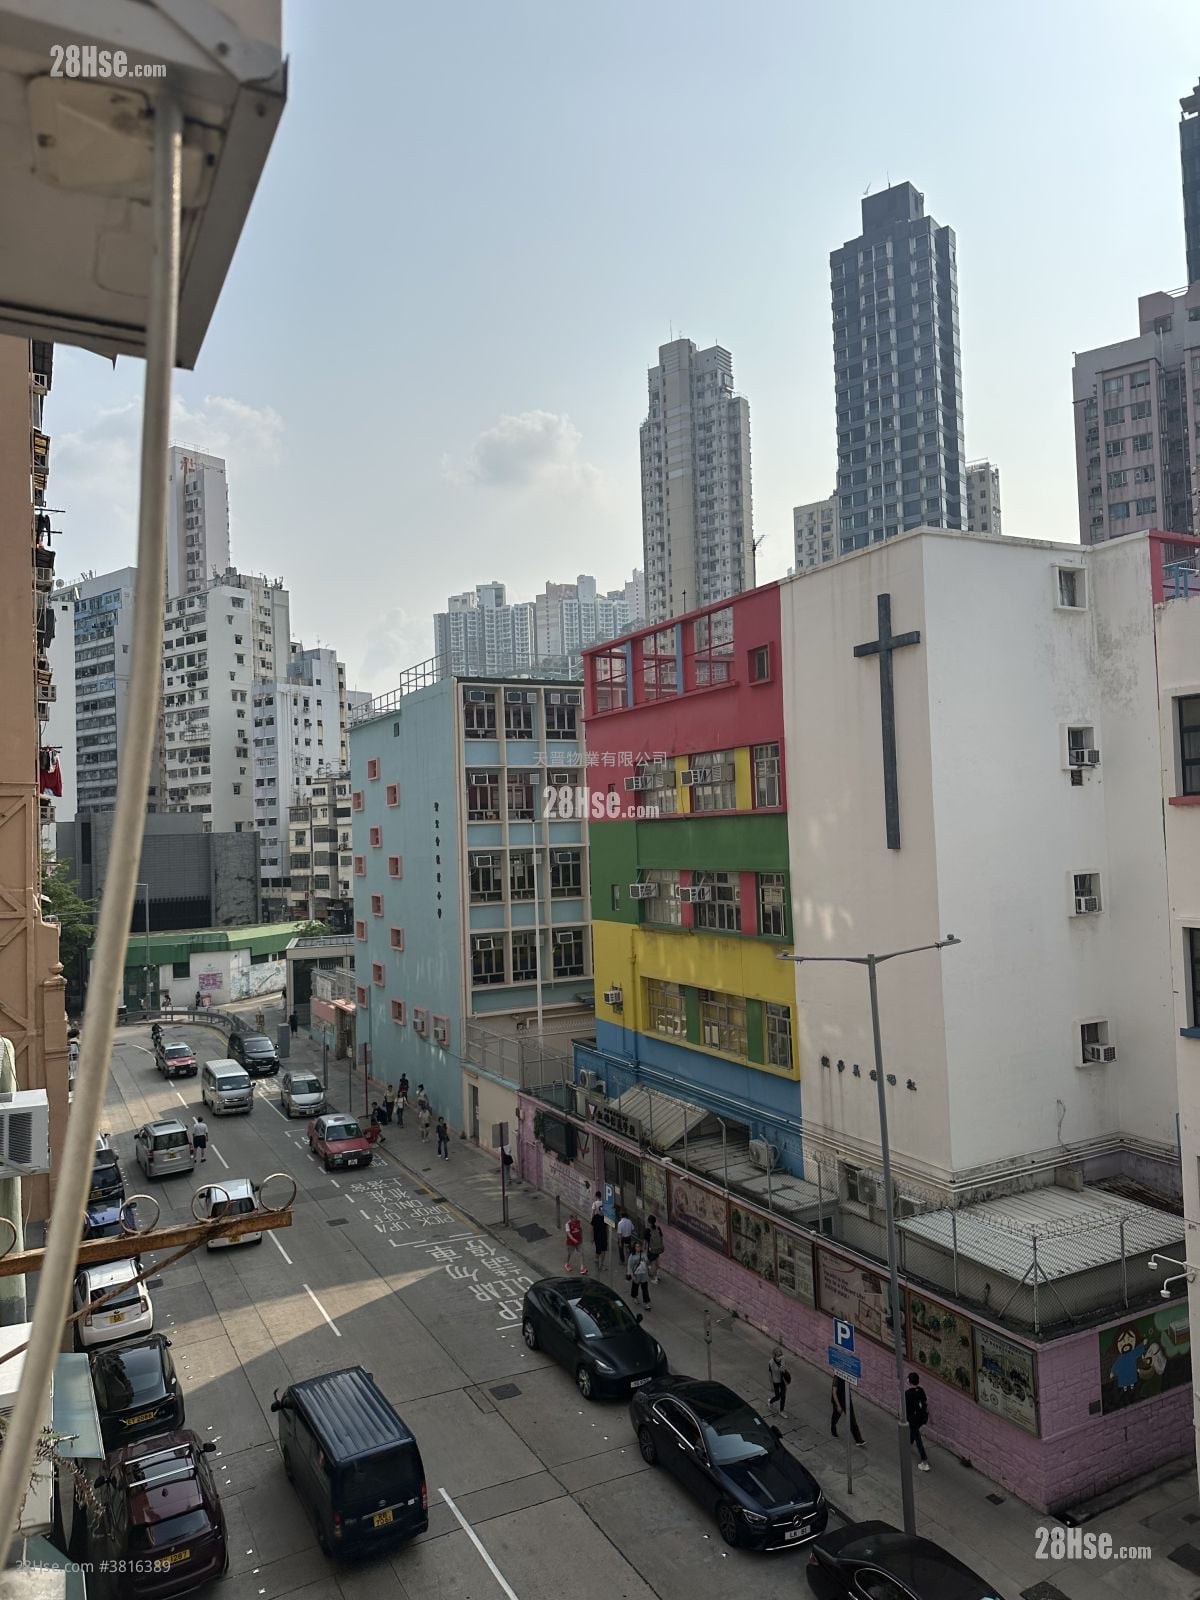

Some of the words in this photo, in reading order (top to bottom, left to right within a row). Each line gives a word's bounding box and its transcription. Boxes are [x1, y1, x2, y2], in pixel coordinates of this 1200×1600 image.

[380, 1199, 423, 1213] ONLY
[410, 1205, 450, 1218] DROP
[374, 1212, 401, 1224] OFF
[417, 1215, 455, 1227] PICK
[468, 1276, 535, 1302] CLEAR
[837, 1322, 850, 1345] P
